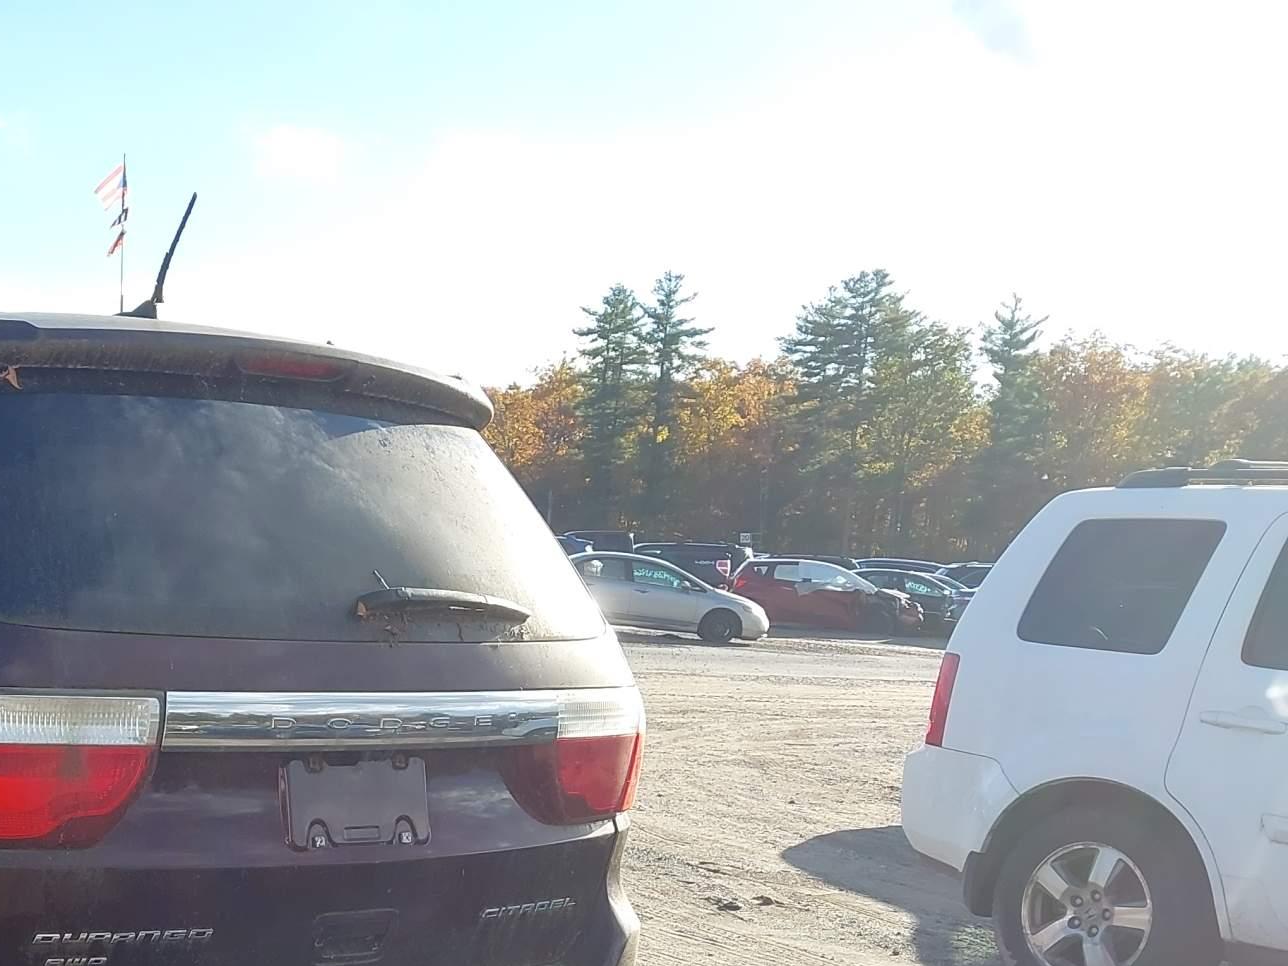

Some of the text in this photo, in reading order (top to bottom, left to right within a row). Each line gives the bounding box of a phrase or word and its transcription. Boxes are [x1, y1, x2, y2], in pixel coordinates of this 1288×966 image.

[271, 714, 494, 730] DODGE
[481, 897, 576, 918] CITADEL
[32, 928, 214, 945] DURANGO
